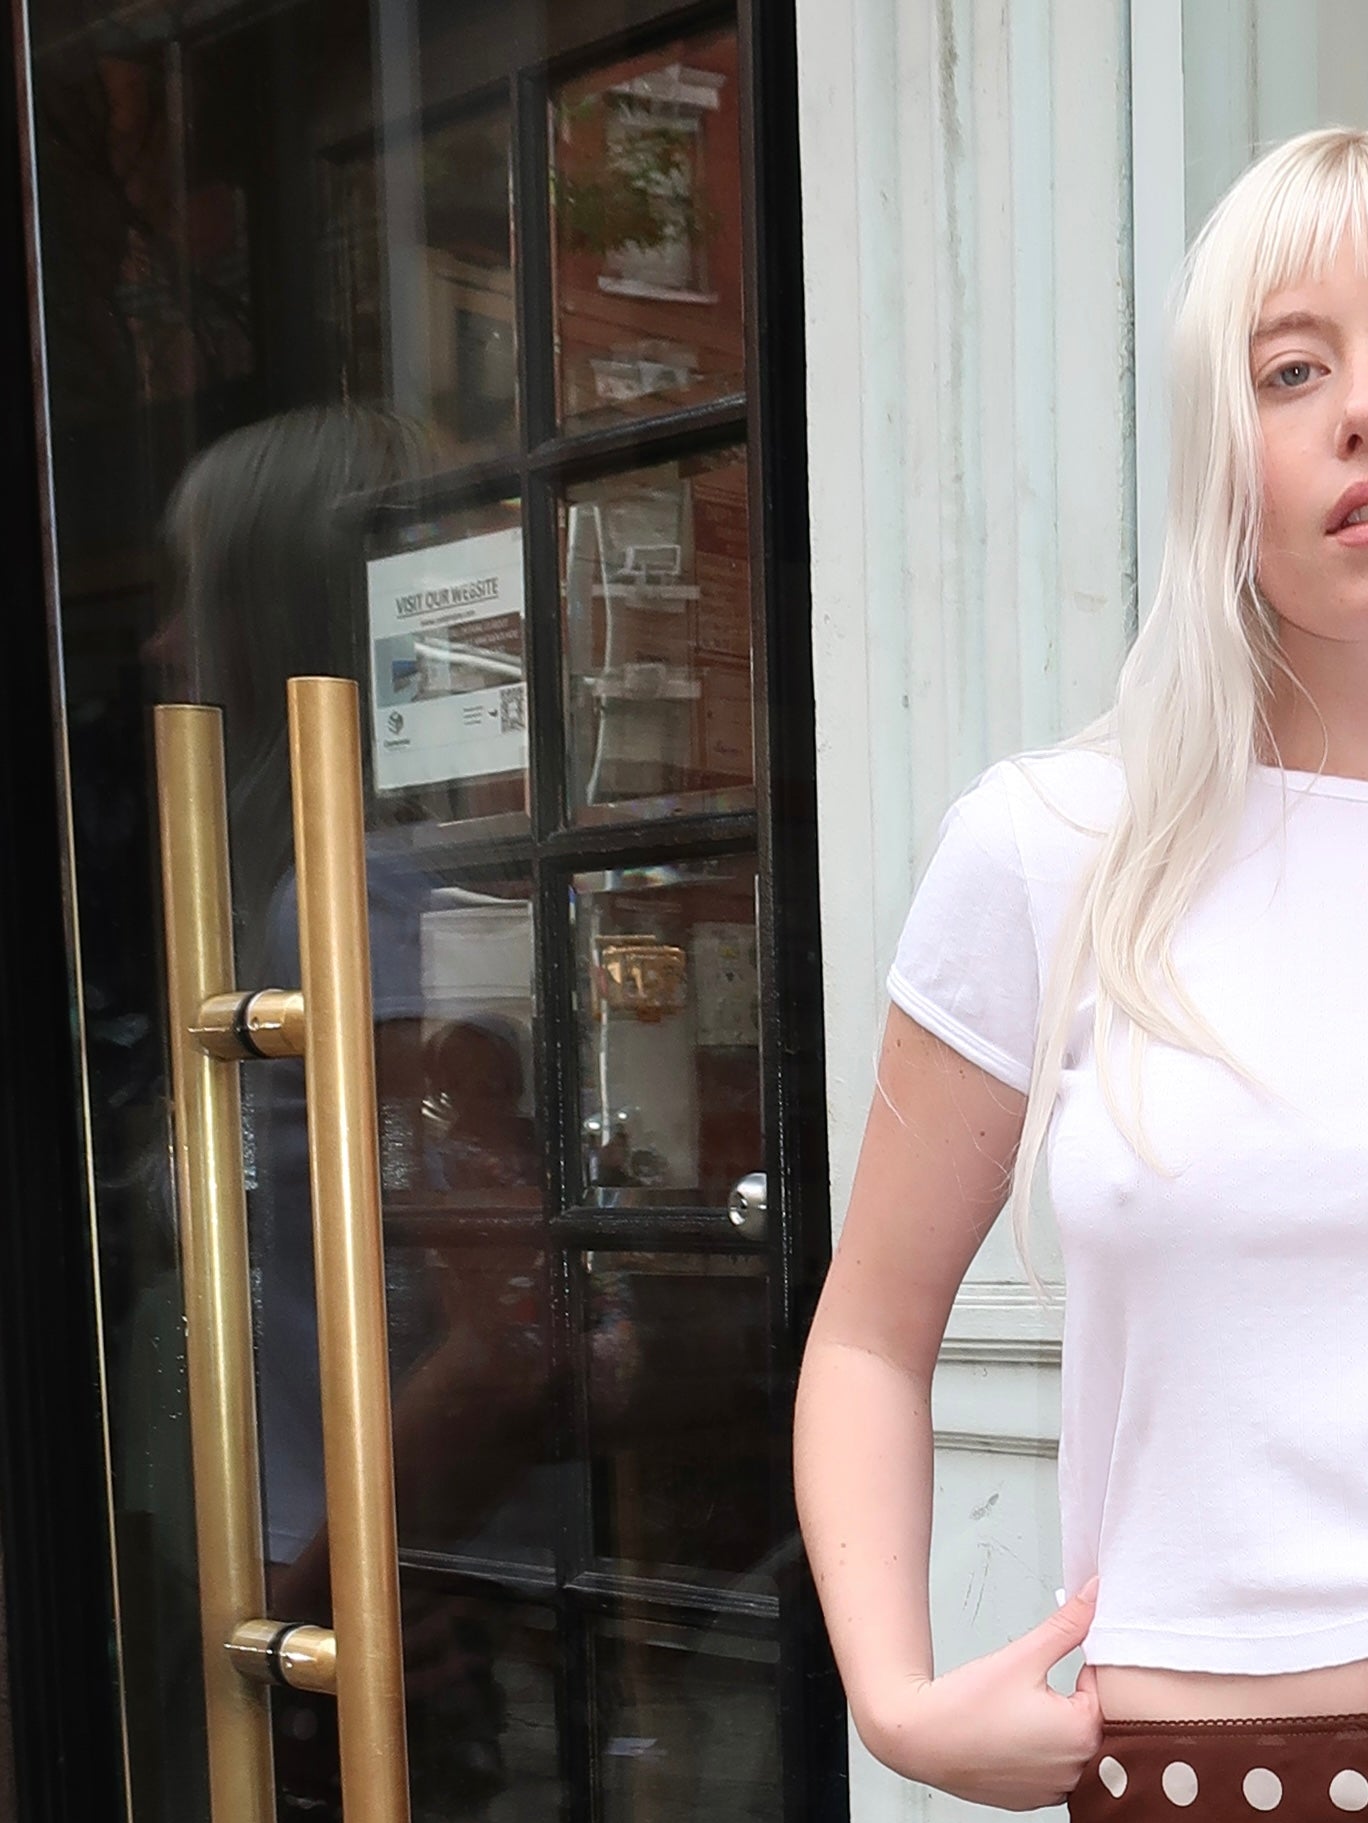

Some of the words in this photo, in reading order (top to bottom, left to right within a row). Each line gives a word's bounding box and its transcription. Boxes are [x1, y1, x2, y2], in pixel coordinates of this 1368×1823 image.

[395, 593, 423, 614] VISIT
[425, 588, 450, 609] OUR
[450, 577, 499, 605] WEBSITE
